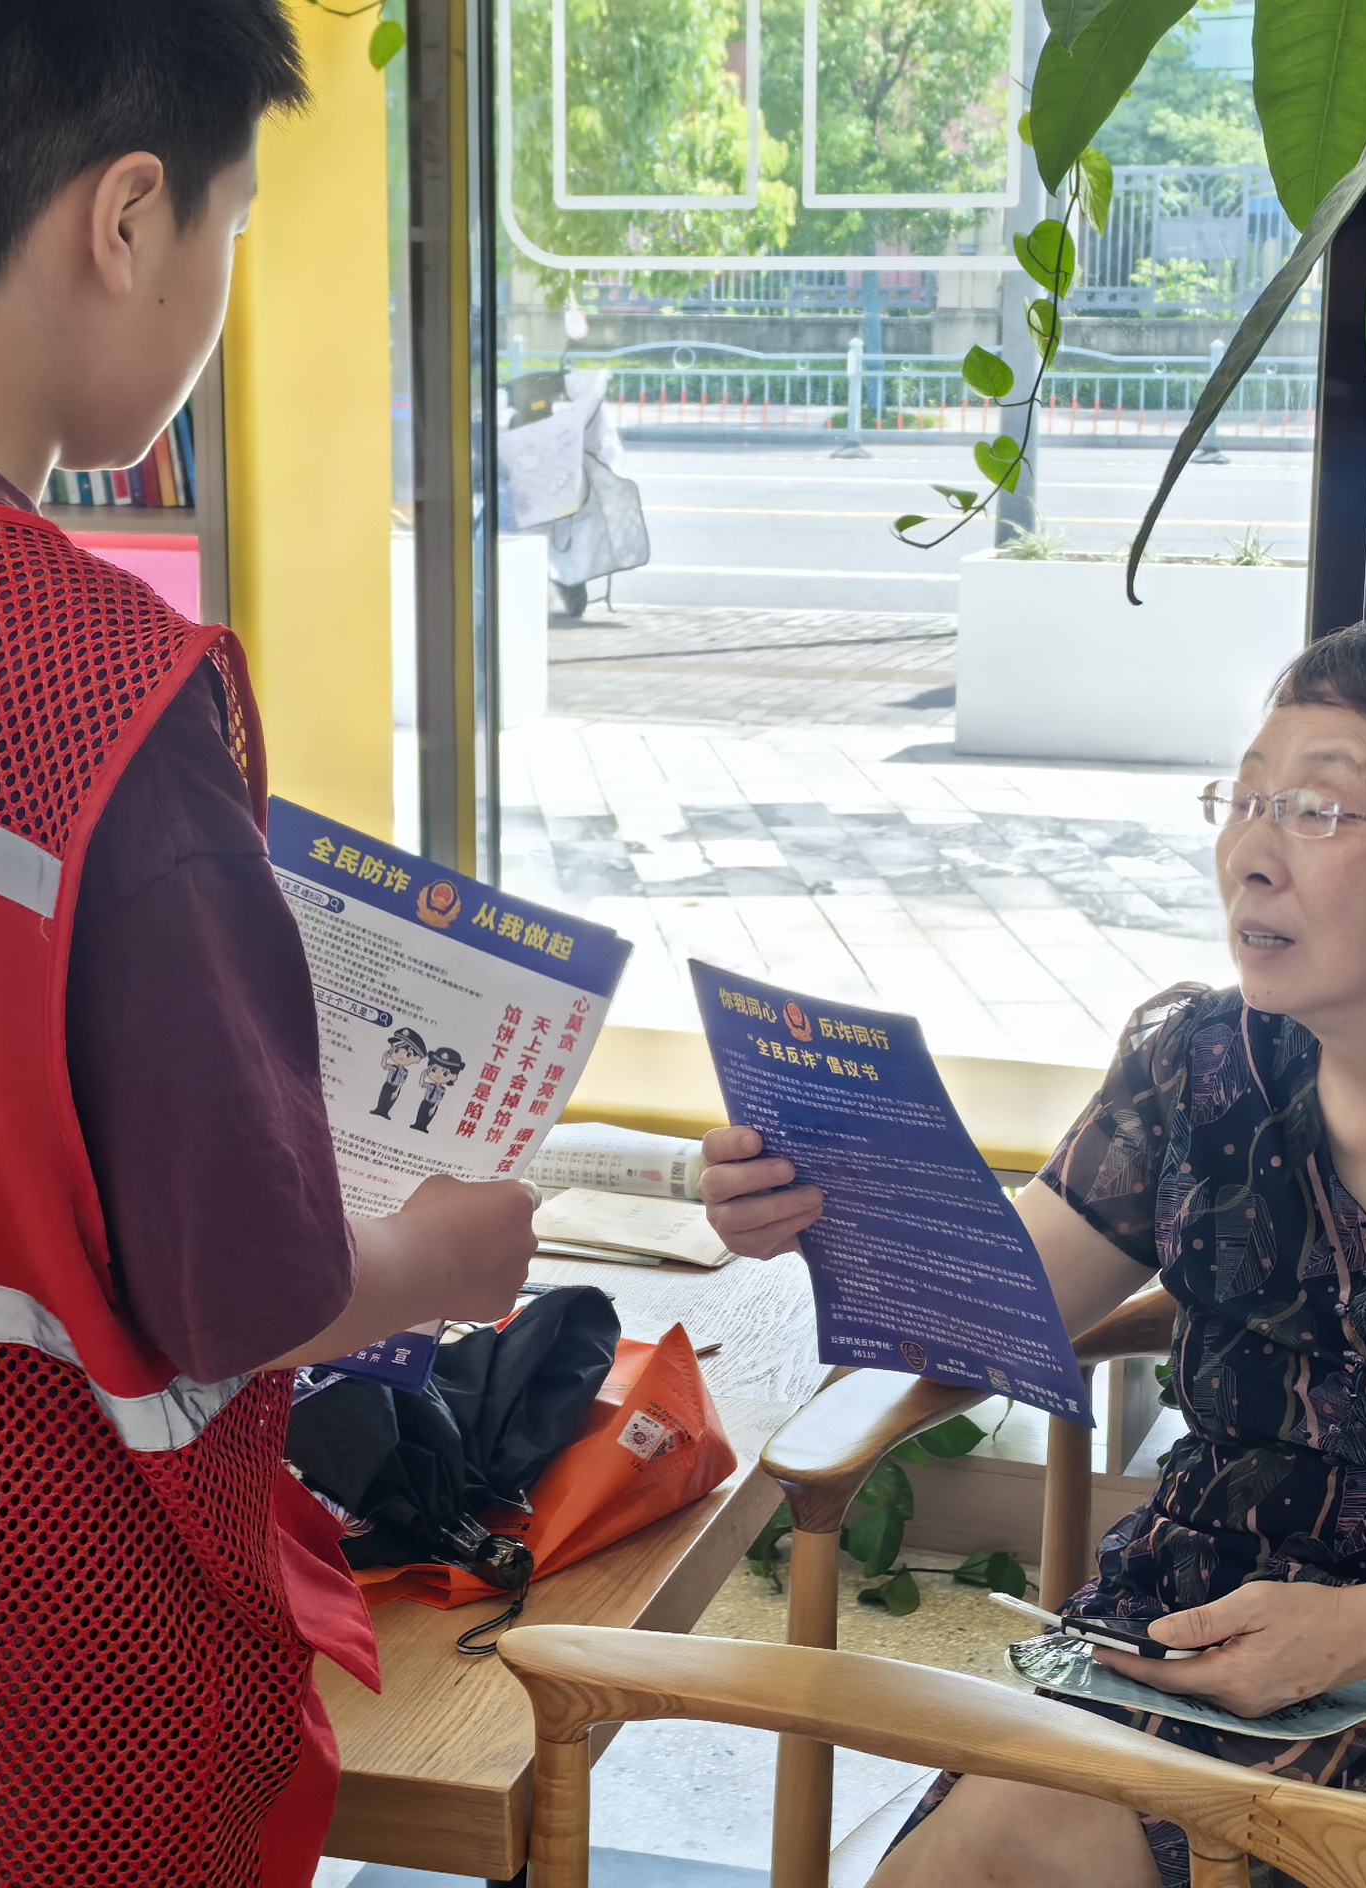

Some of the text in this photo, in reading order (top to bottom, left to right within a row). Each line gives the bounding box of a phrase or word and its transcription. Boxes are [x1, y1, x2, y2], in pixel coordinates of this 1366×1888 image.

[308, 836, 576, 961] 全民防诈 从我做起
[455, 1003, 524, 1139] 馅饼下面是陷阱
[484, 1015, 552, 1145] 天上不会掉馅饼
[718, 987, 890, 1050] 你我同心 反诈同行
[495, 995, 591, 1174] 心莫贪 擦亮眼 绷紧弦
[390, 1347, 412, 1366] 宣
